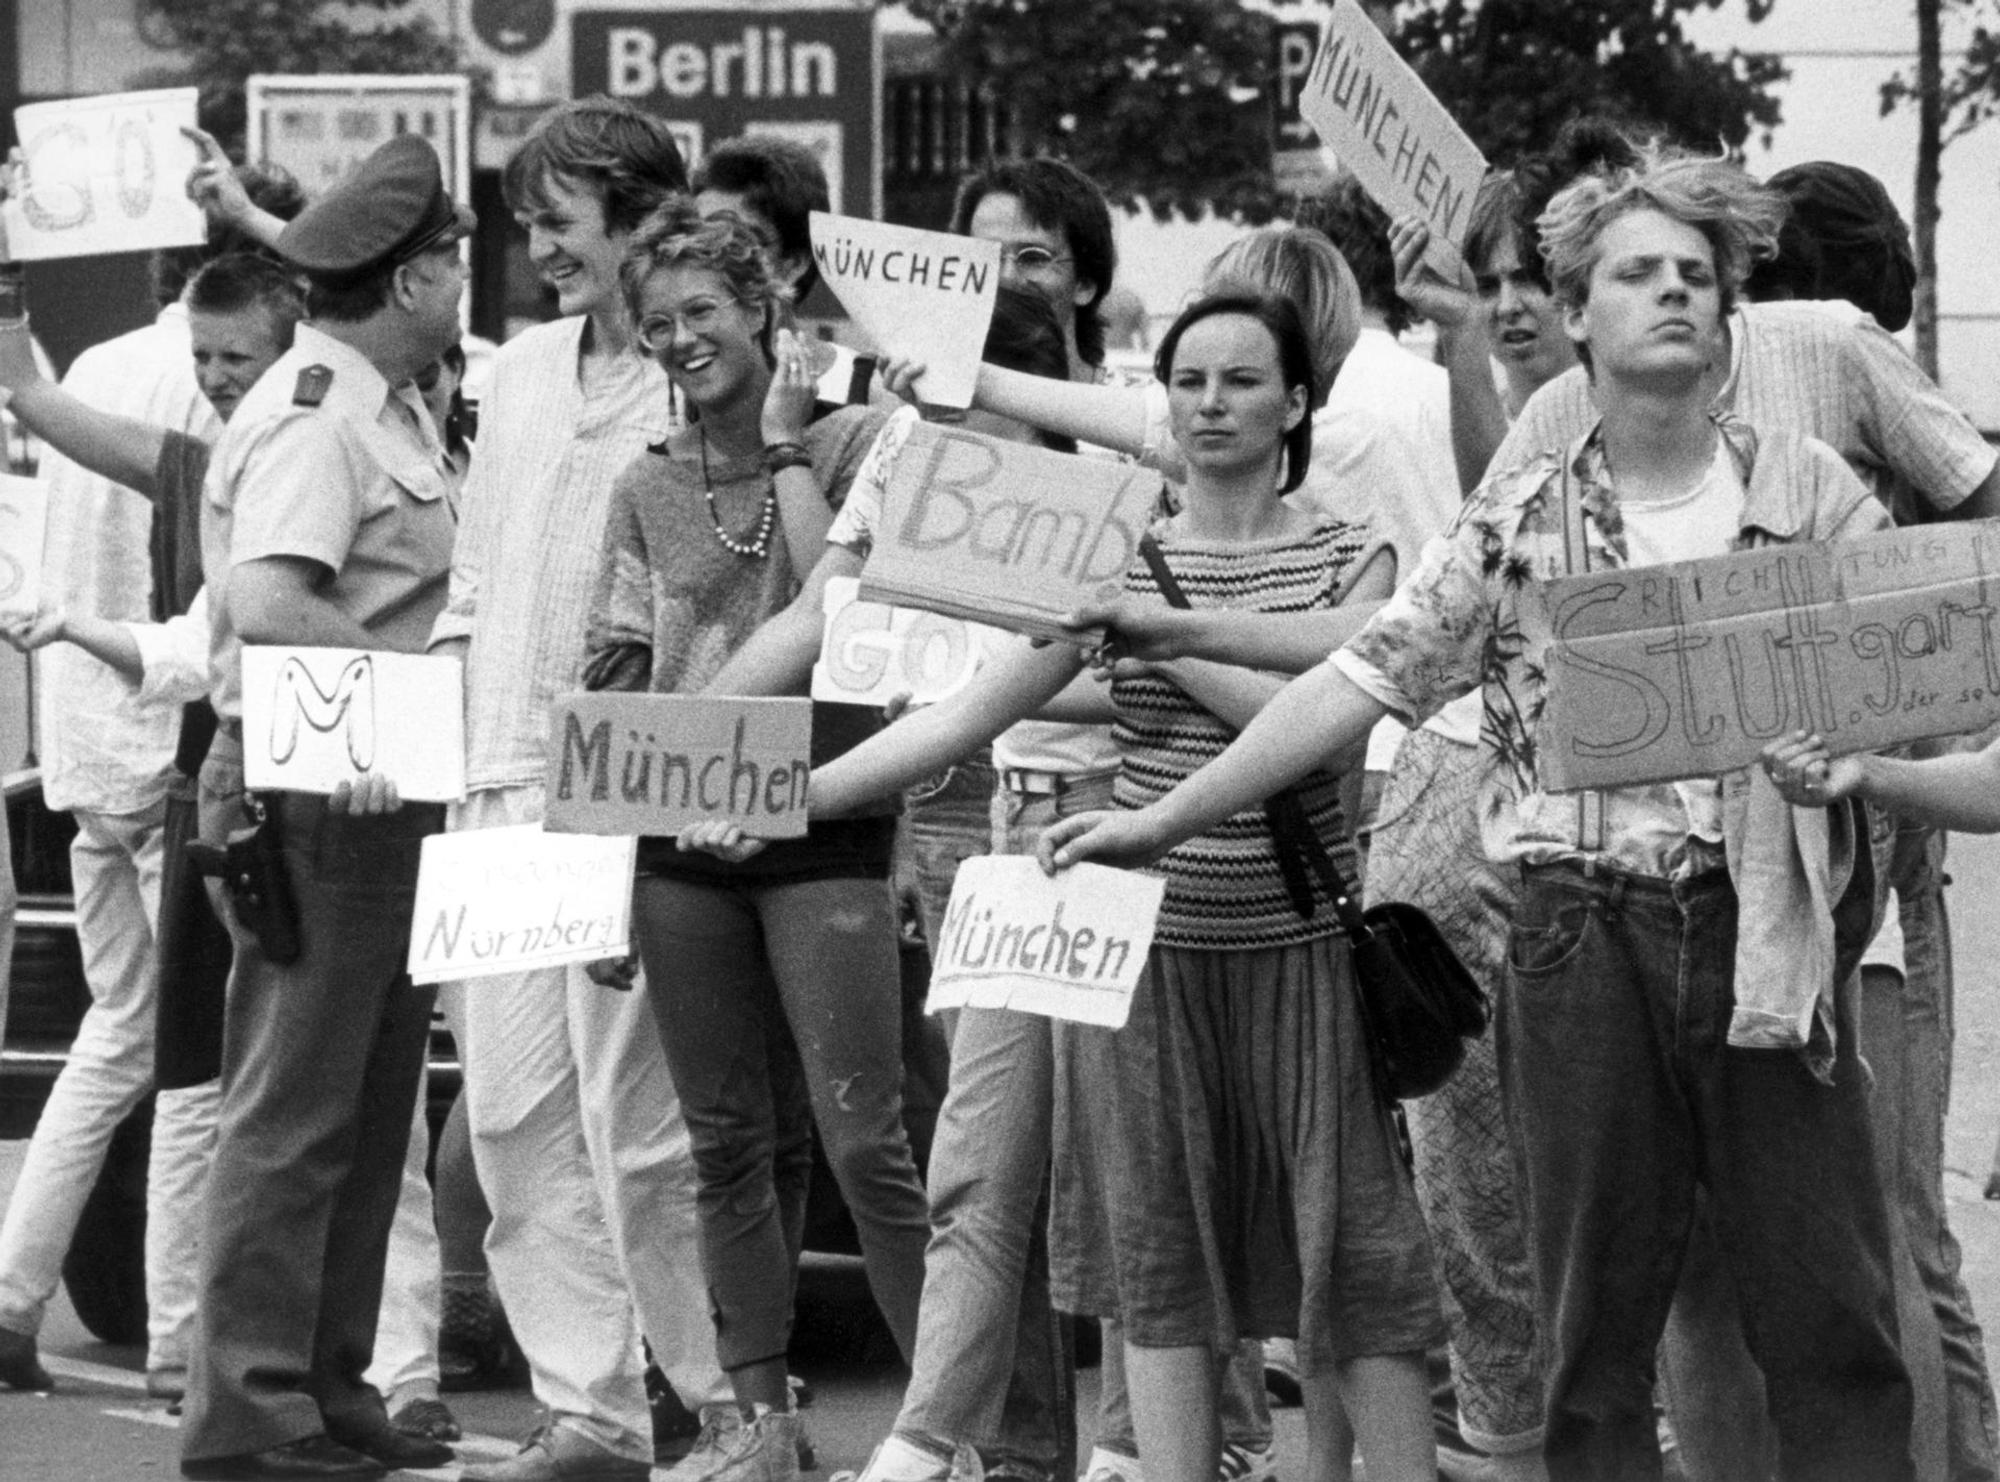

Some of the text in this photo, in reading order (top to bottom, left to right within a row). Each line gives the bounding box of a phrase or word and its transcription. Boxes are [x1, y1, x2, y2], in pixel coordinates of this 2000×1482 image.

[607, 26, 837, 98] Berlin
[1281, 33, 1312, 107] P
[1313, 24, 1464, 239] MÜNCHEN
[269, 654, 376, 773] M
[557, 710, 810, 816] München
[423, 898, 614, 962] Nürnberg
[936, 892, 1131, 980] München
